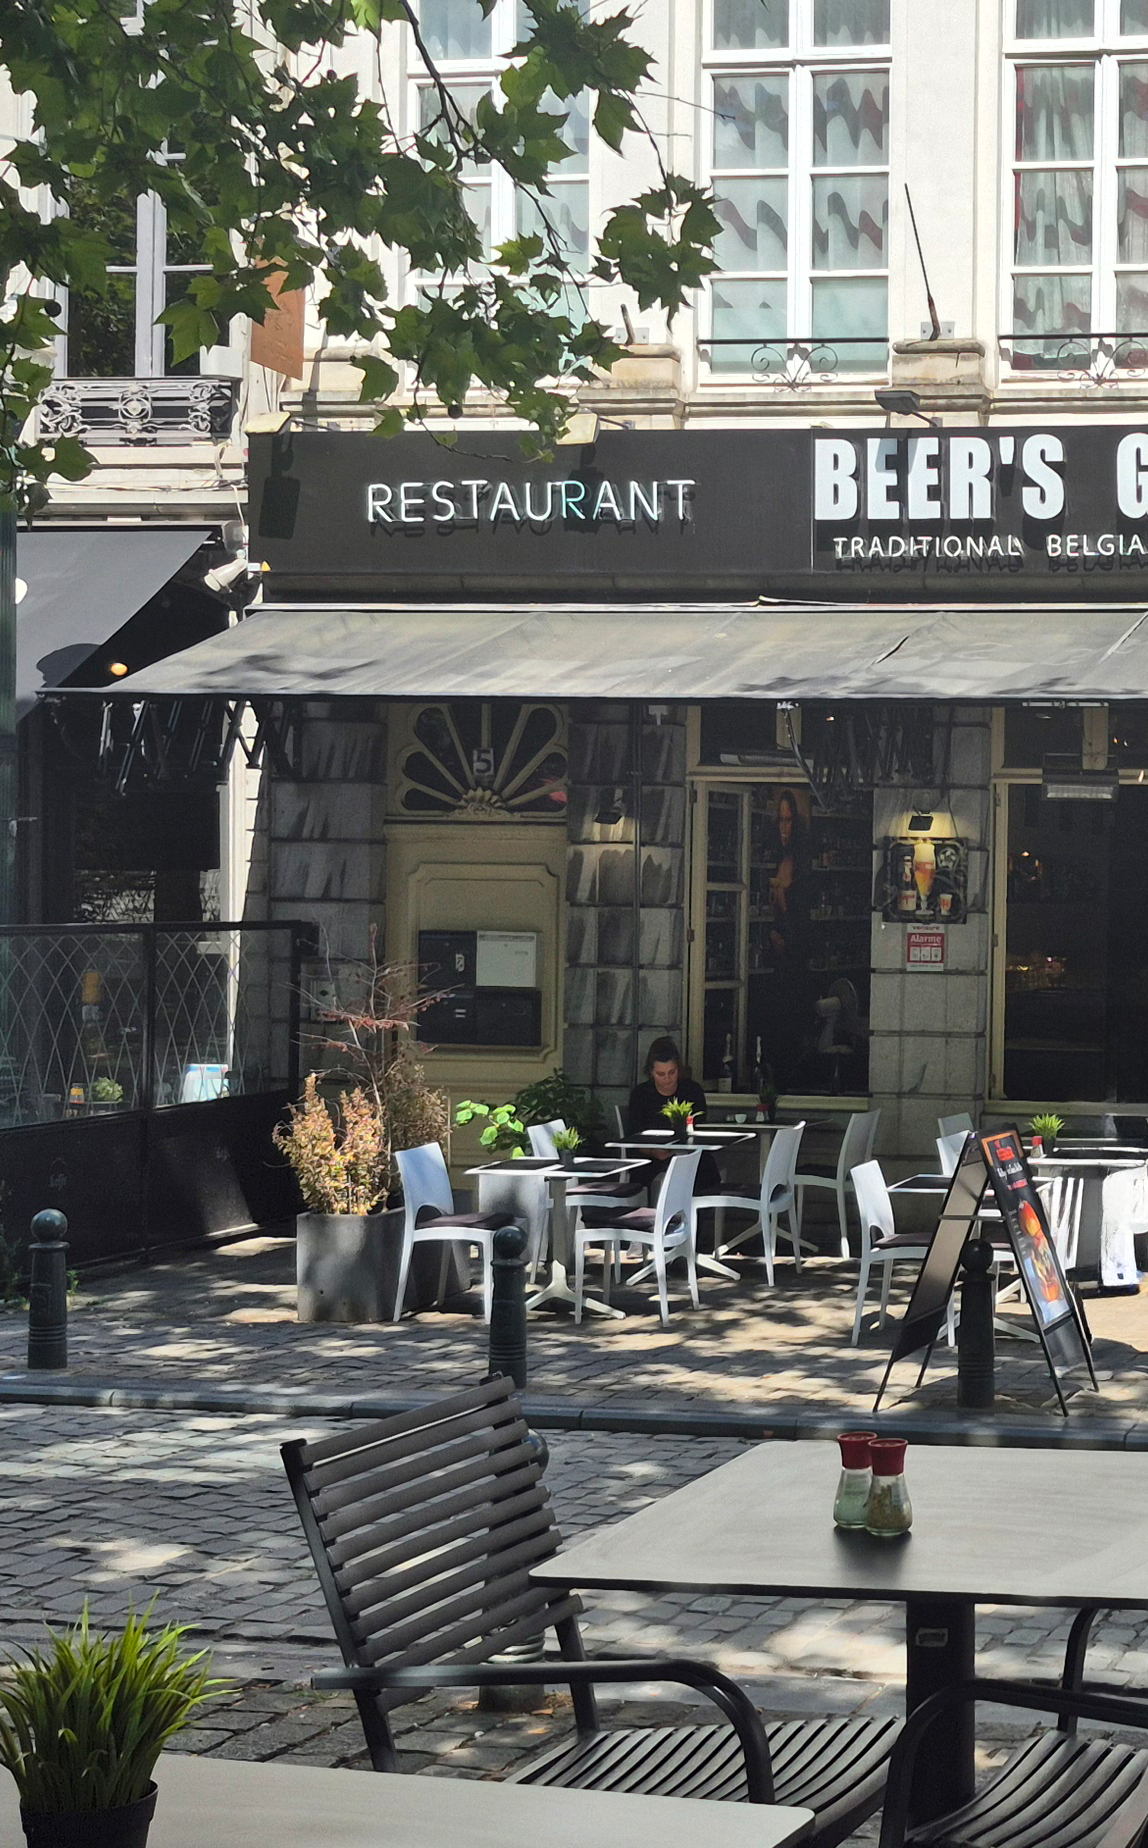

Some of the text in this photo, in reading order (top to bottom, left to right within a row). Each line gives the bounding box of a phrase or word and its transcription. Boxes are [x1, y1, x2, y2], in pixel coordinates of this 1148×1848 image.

[814, 433, 1065, 521] BEER'S
[366, 479, 696, 523] RESTAURANT
[833, 535, 1022, 558] TRADITIONAL
[475, 750, 492, 774] 5
[910, 933, 942, 943] Alarme
